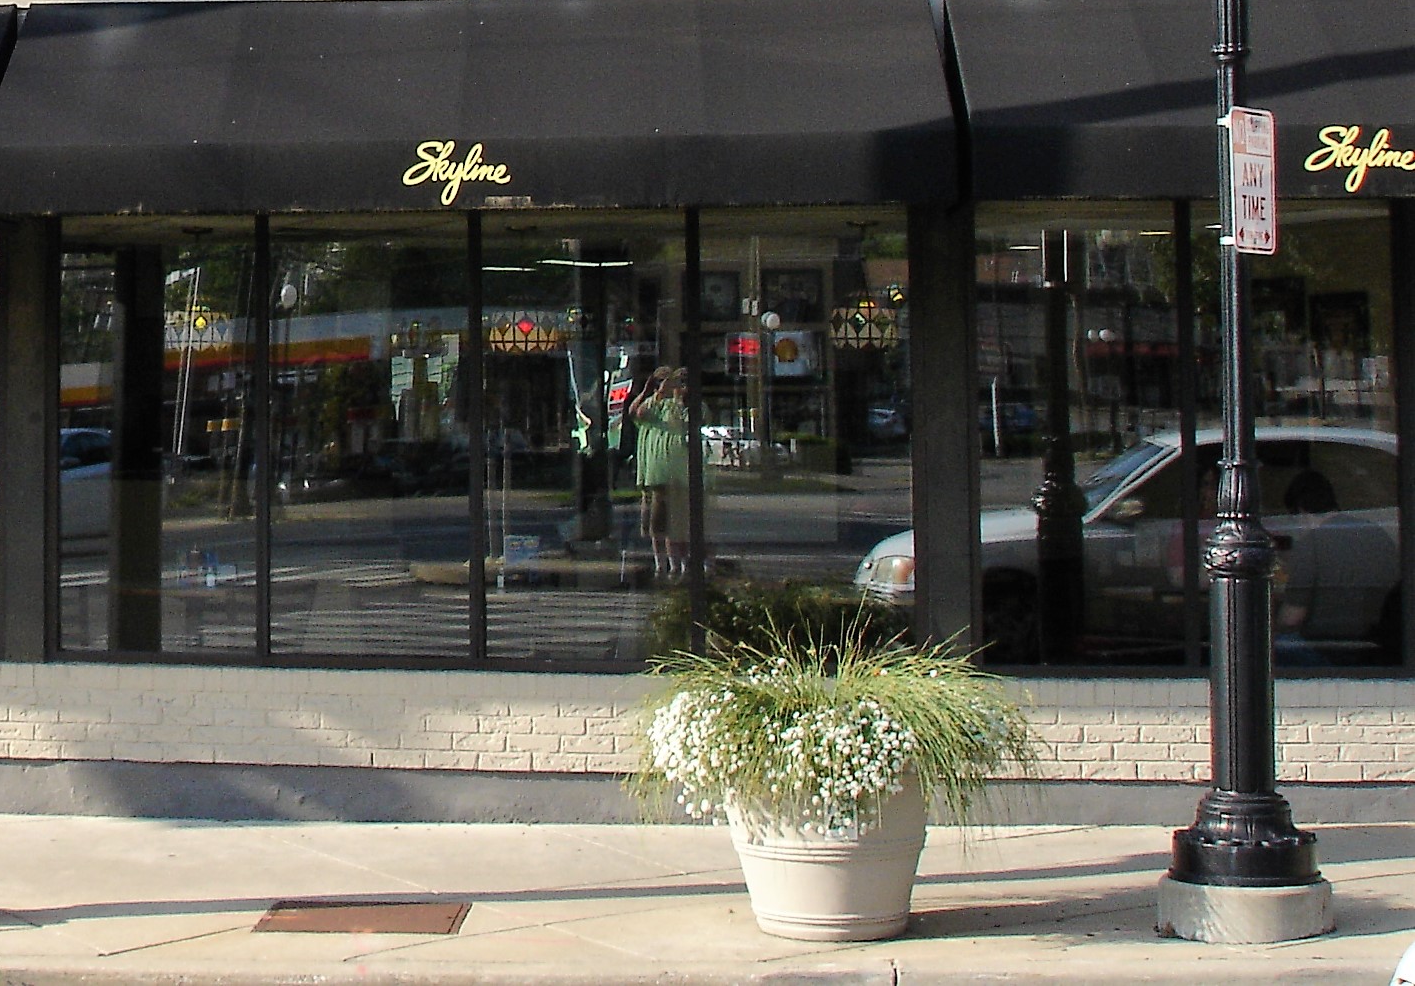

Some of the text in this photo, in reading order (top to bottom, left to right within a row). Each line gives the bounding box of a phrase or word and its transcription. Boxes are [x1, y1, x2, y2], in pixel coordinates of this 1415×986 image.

[402, 140, 511, 206] Skyline
[1242, 162, 1264, 188] ANY
[1304, 125, 1415, 193] Skyline
[1242, 195, 1266, 221] TIME
